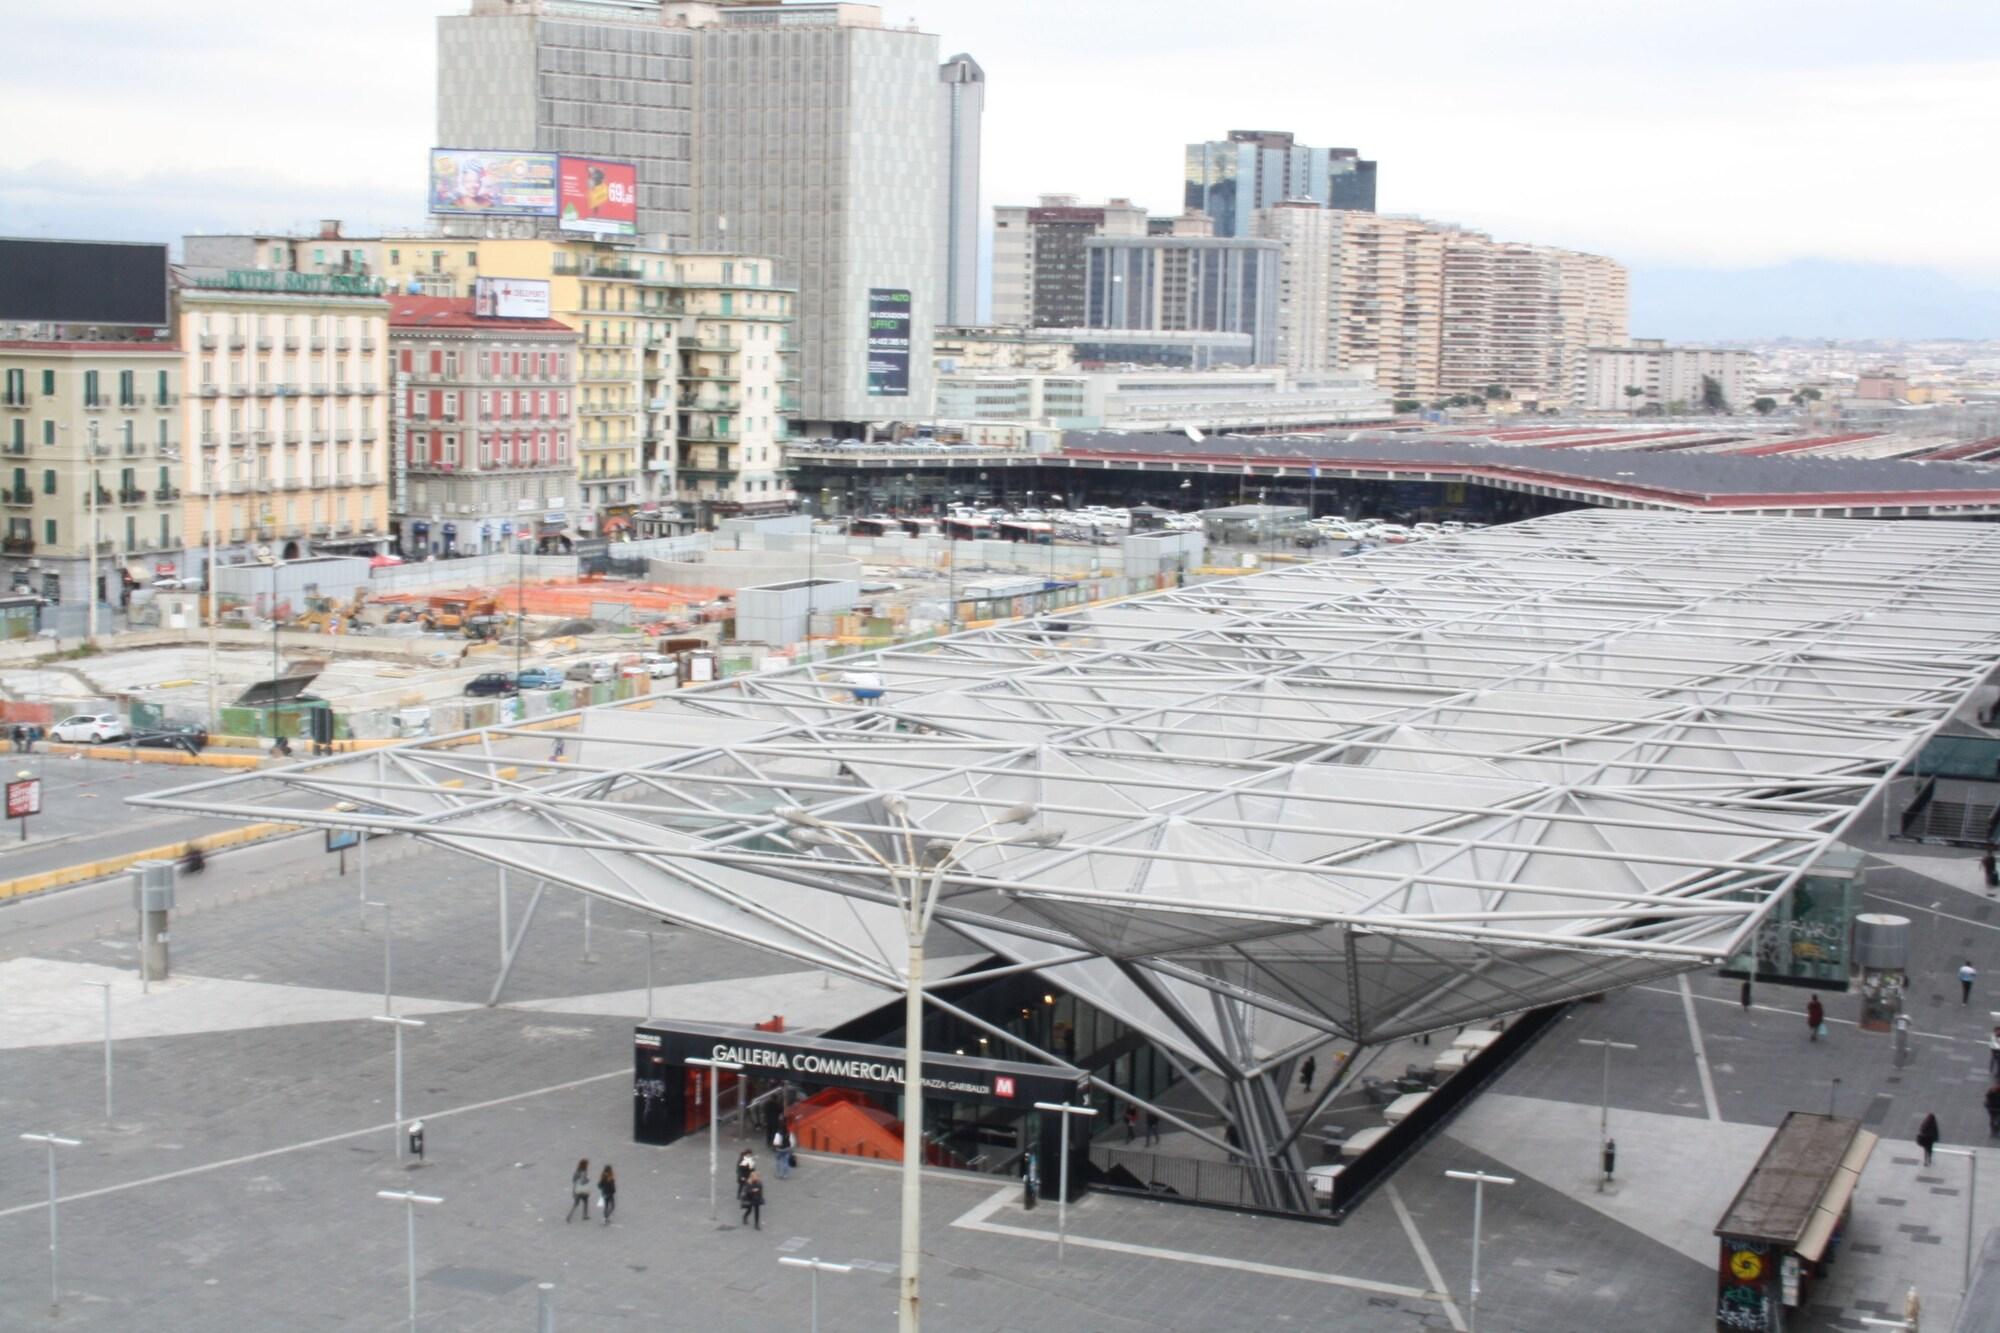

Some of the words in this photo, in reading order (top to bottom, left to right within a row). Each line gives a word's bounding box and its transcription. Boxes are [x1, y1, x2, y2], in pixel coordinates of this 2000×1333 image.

[712, 1044, 790, 1069] GALLERIA
[792, 1054, 907, 1084] COMMERCIAL
[947, 1081, 990, 1095] GARIBALDI
[996, 1079, 1014, 1095] M
